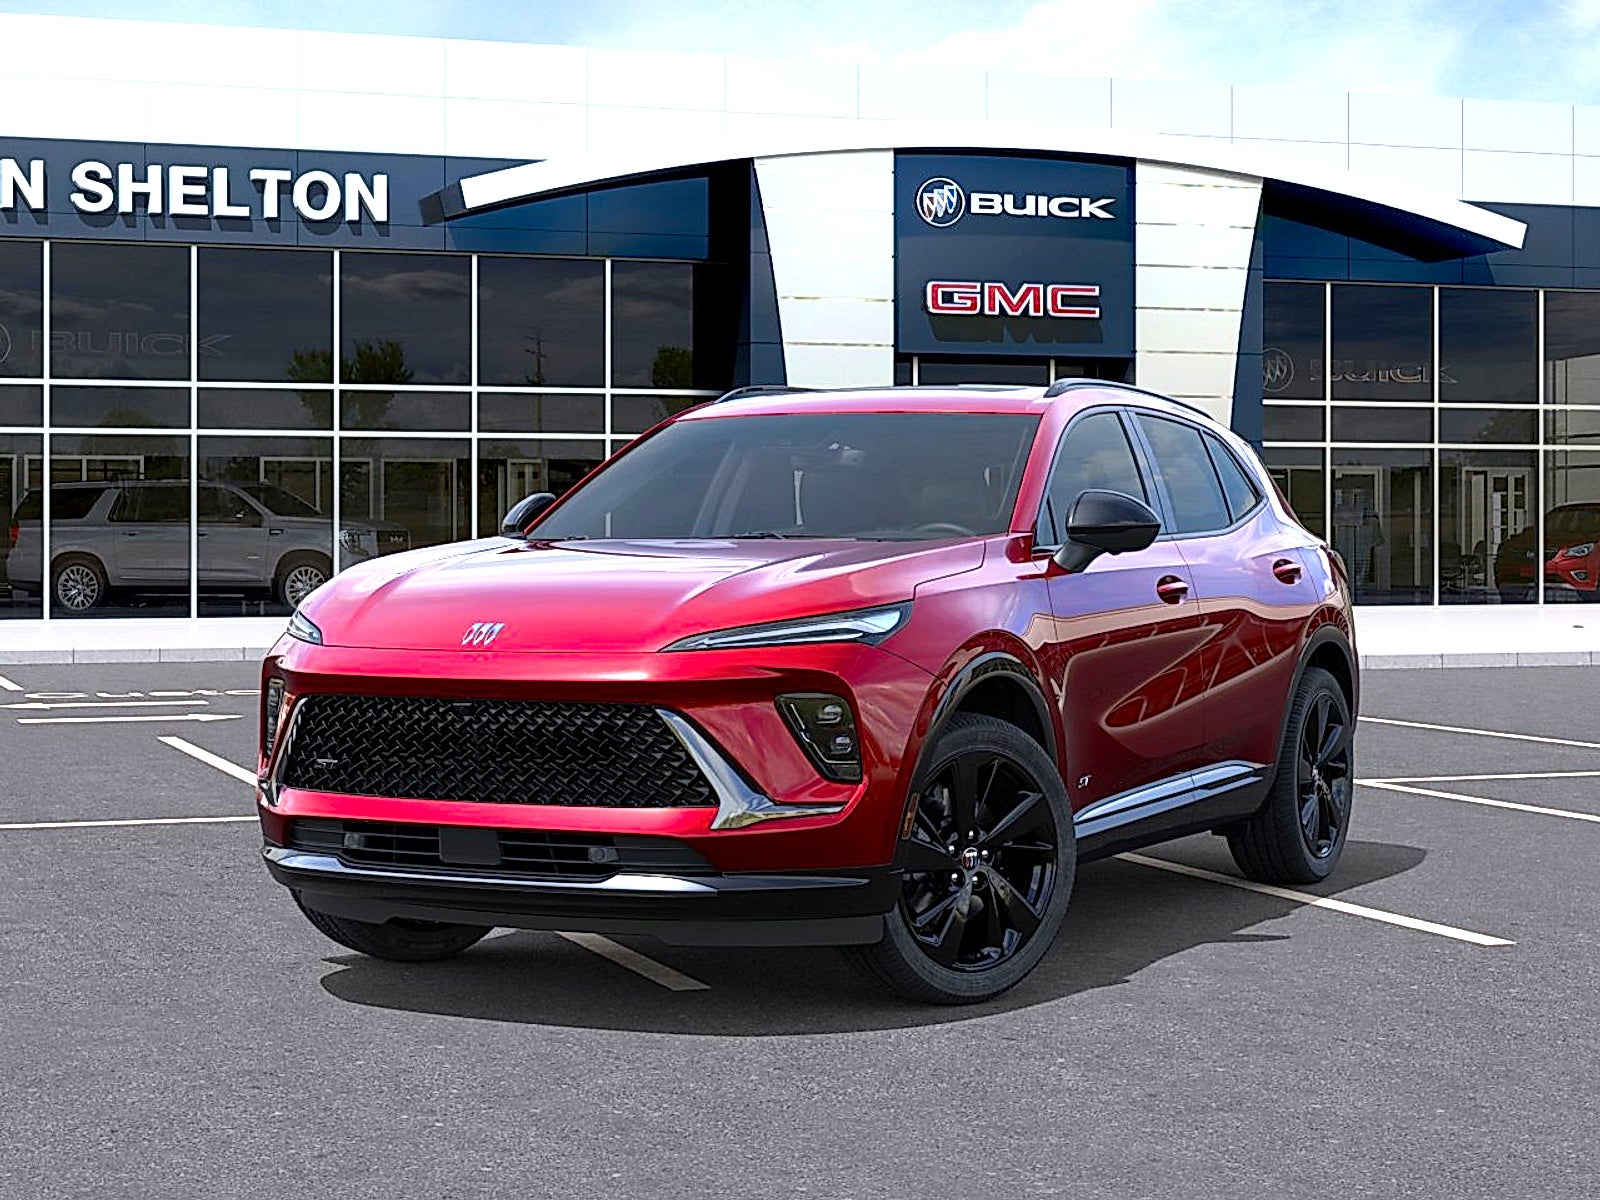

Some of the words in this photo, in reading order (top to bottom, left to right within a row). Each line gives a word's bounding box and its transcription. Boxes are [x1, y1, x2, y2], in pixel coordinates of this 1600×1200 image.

[69, 160, 389, 223] SHELTON
[969, 191, 1118, 219] BUICK
[925, 280, 1101, 319] GMC
